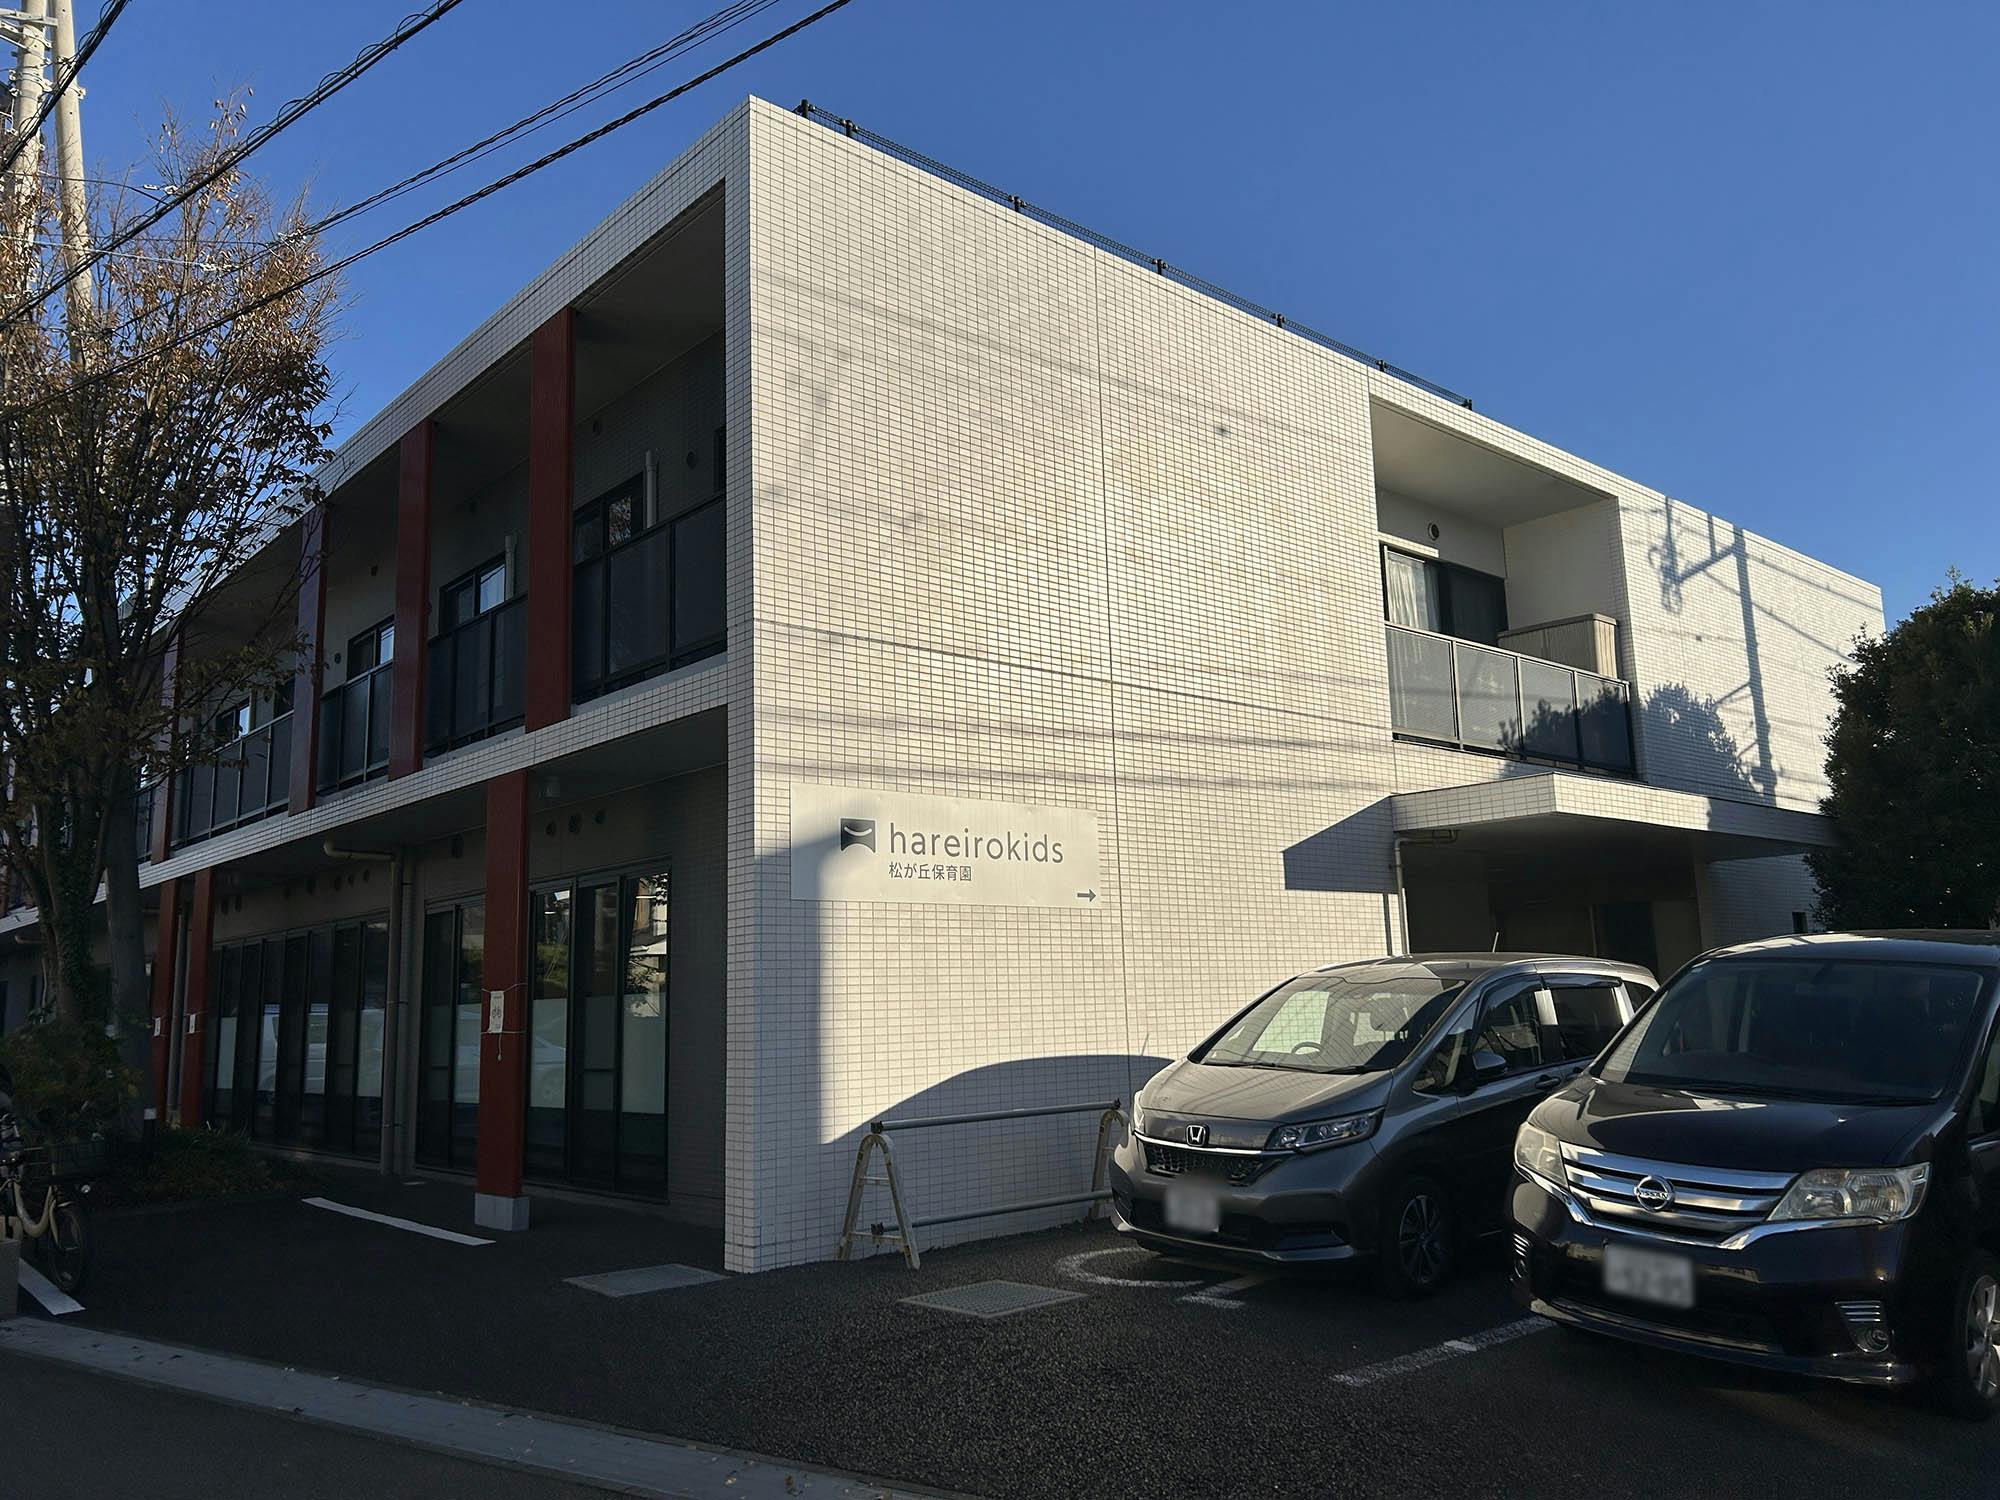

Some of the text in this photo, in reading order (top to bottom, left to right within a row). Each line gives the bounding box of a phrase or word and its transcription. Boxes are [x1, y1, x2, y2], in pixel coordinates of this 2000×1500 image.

[890, 822, 1063, 863] hareirokids
[888, 861, 972, 881] 松が丘保育園
